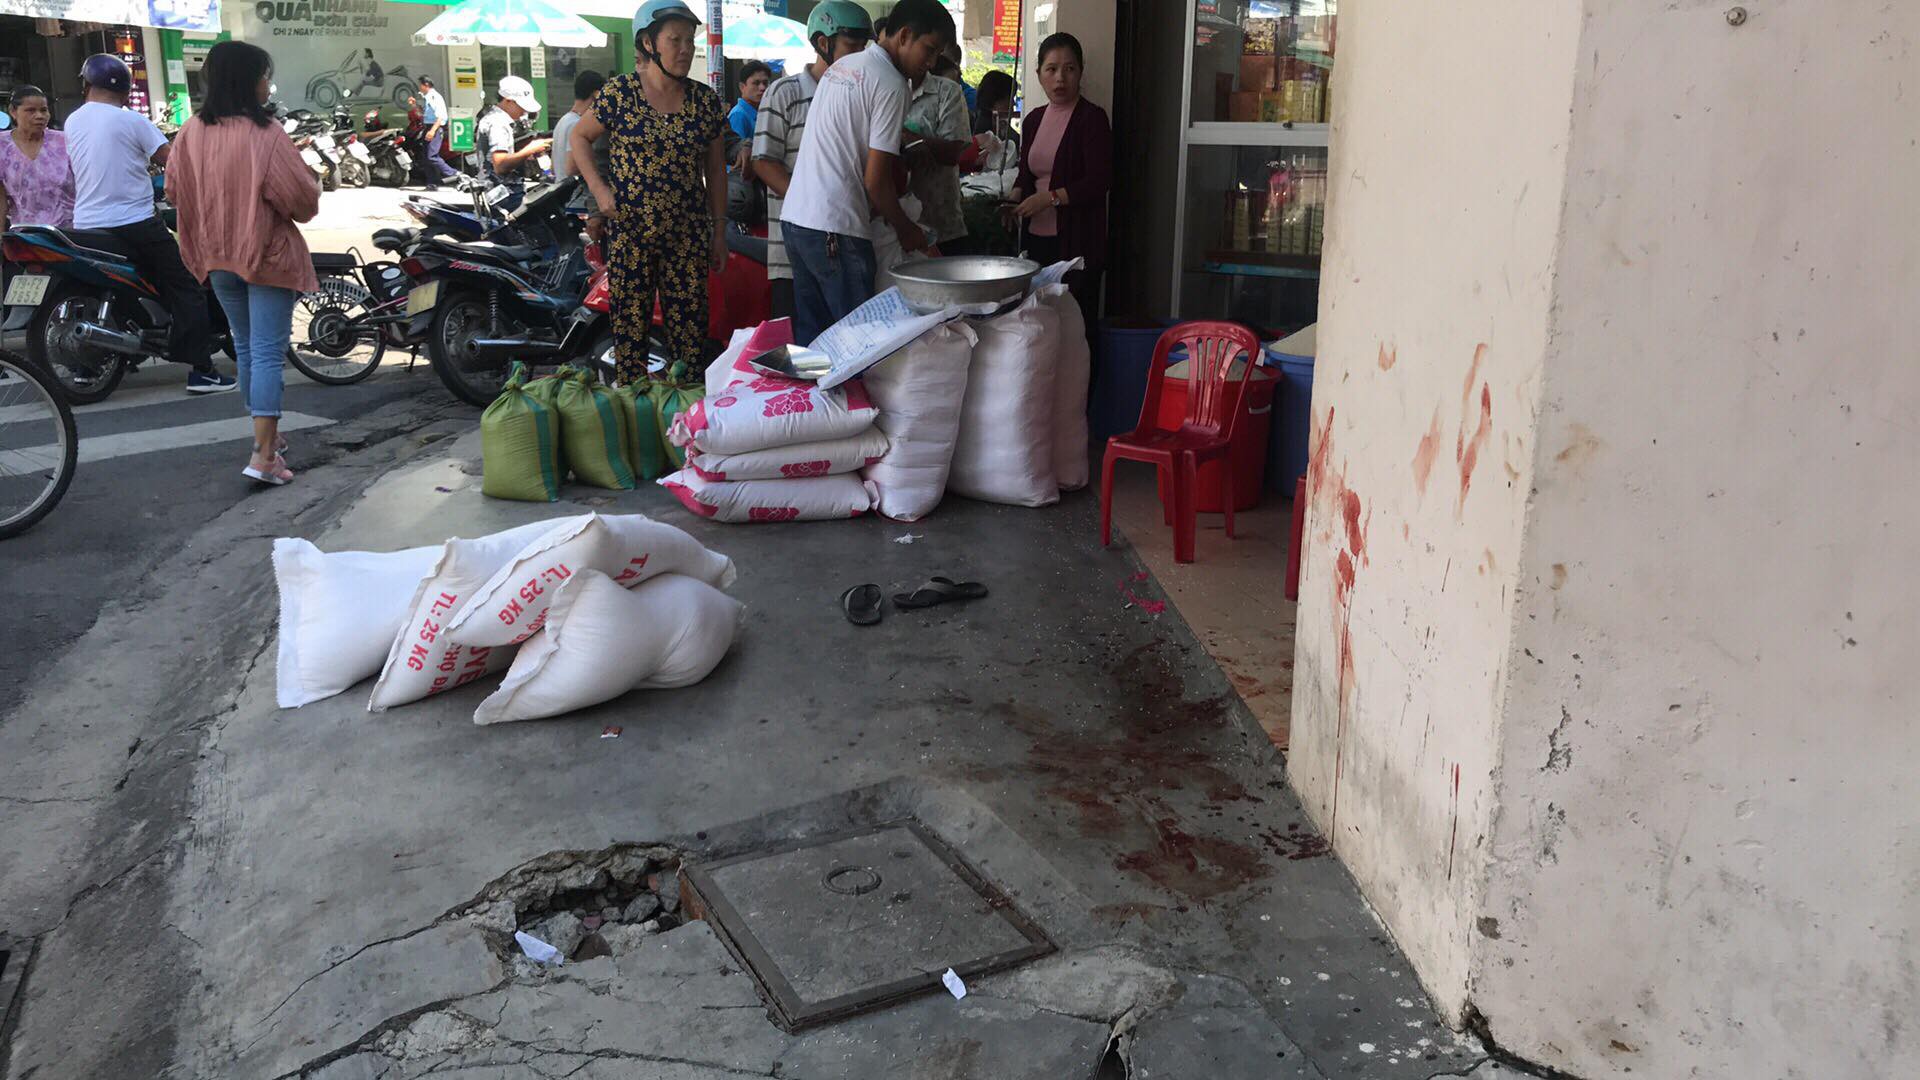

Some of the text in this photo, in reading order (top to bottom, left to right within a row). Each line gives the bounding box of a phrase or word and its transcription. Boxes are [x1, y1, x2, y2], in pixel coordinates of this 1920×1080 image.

[453, 121, 464, 143] P
[519, 578, 544, 604] 25
[498, 598, 524, 626] KG
[420, 618, 440, 643] 25
[407, 643, 429, 671] KG
